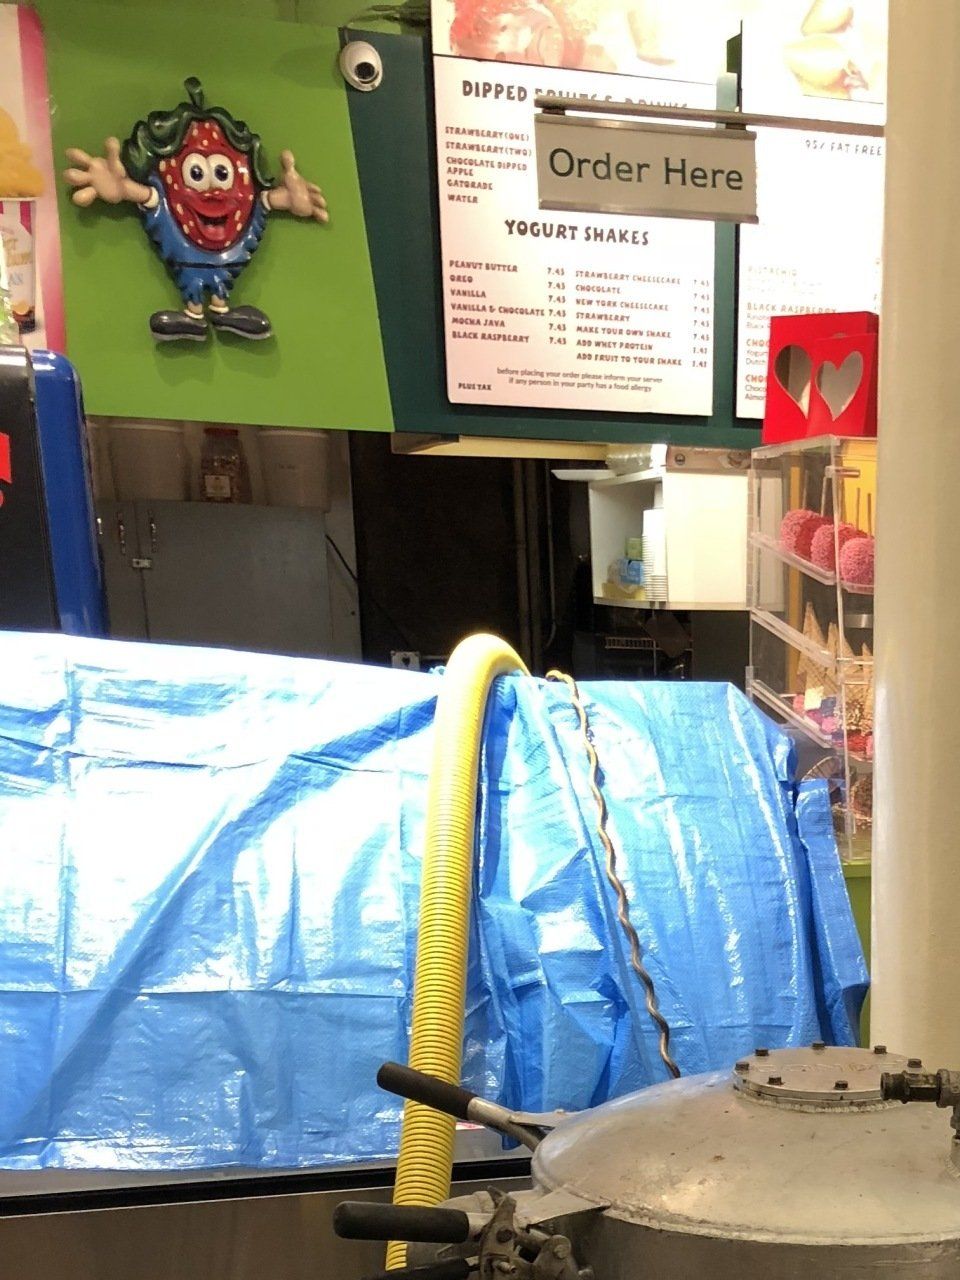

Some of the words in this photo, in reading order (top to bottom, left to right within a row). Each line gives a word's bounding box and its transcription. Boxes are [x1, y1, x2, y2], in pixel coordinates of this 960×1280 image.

[462, 80, 528, 102] DIPPED
[830, 142, 850, 153] FAT
[854, 144, 882, 156] FREE
[446, 156, 495, 169] CHOCOLATE
[497, 160, 528, 172] DIPPED
[548, 147, 649, 184] Order
[664, 156, 744, 191] Here
[446, 167, 474, 177] APPLE
[446, 179, 493, 191] GATORADE
[447, 193, 478, 204] WATER
[504, 218, 577, 243] YOGURT
[584, 225, 650, 247] SHAKES
[449, 259, 483, 270] PEANUT
[485, 262, 518, 272] BUTTER
[449, 274, 473, 284] OREO
[575, 270, 630, 281] STRAWBERRY
[632, 275, 681, 285] CHEESECAKE
[450, 288, 487, 298] VANILLA
[575, 284, 621, 294] CHOCOLATE
[451, 303, 487, 313] VANILLA
[498, 306, 545, 317] CHOCOLATE
[575, 298, 593, 306] NEW
[595, 299, 618, 308] YORK
[620, 301, 669, 311] CHEESECAKE
[747, 302, 777, 312] BLACK
[452, 317, 481, 326] MOCHA
[483, 319, 506, 328] JAVA
[575, 312, 630, 322] STRAWBERRY
[452, 331, 479, 340] BLACK
[481, 333, 530, 343] RASPBERRY
[576, 325, 599, 334] MAKE
[601, 327, 624, 336] YOUR
[625, 328, 644, 337] OWN
[646, 330, 671, 339] SHAKE
[576, 339, 592, 347] ADD
[594, 340, 617, 349] WHEY
[619, 342, 653, 351] PROTEIN
[594, 353, 619, 362] FRUIT
[621, 355, 631, 363] TO
[633, 356, 655, 365] YOUR
[657, 358, 682, 366] SHAKE
[496, 366, 519, 376] before
[520, 368, 545, 379] placing
[546, 370, 561, 379] your
[562, 369, 580, 379] order
[581, 371, 603, 382] please
[603, 373, 626, 382] inform
[627, 375, 641, 384] your
[642, 375, 663, 384] server
[458, 382, 476, 391] PLUS
[477, 383, 492, 391] TAX
[515, 378, 527, 387] any
[528, 379, 551, 388] person
[552, 378, 560, 387] in
[560, 380, 576, 389] your
[577, 380, 594, 390] party
[595, 381, 607, 389] has
[613, 381, 629, 391] food
[630, 383, 652, 393] allergy
